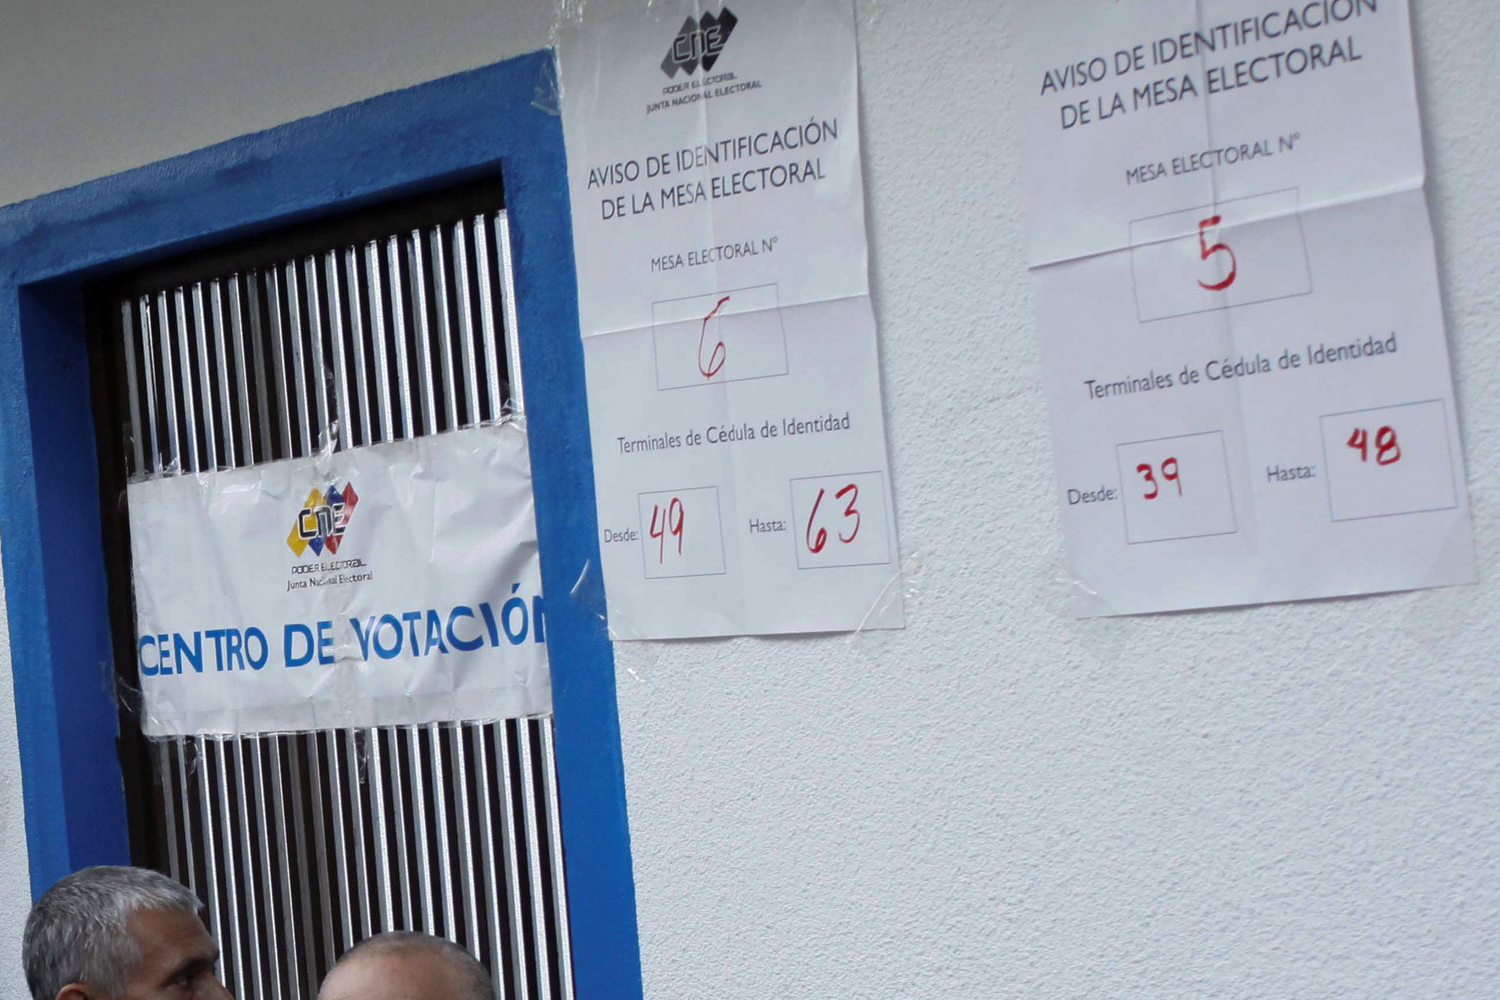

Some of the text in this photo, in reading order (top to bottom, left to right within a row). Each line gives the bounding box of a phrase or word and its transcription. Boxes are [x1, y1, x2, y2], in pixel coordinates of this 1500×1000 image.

[672, 25, 724, 63] CNE
[662, 83, 690, 95] PODER
[1040, 57, 1107, 96] AVISO
[1114, 45, 1145, 76] DE
[1060, 36, 1363, 130] DE LA MESA ELECTORAL
[646, 101, 670, 115] JUNTA
[715, 80, 762, 98] ELECTORAL
[587, 117, 838, 190] AVISO DE IDENTIFICACIÓN
[1126, 162, 1168, 186] MESA
[1172, 139, 1274, 176] ELECTORAL
[601, 157, 826, 220] DE LA MESA ELECTORAL
[651, 254, 685, 273] MESA
[688, 241, 758, 267] ELECTORAL
[1197, 215, 1237, 291] 5
[698, 295, 730, 380] 6
[1084, 331, 1397, 400] Terminales de Cédula de Identidad
[617, 411, 850, 454] Terminales de Cédula de Identidad
[1346, 425, 1401, 466] 48
[1136, 456, 1183, 500] 39
[1267, 464, 1316, 482] Hasta:
[1067, 485, 1118, 505] Desde:
[298, 502, 347, 540] CNE
[604, 529, 639, 543] Desde:
[650, 496, 685, 564] 49
[750, 518, 787, 534] Hasta:
[806, 483, 860, 554] 63
[287, 580, 307, 593] Junta
[338, 570, 373, 585] Electoral
[291, 558, 367, 575] PODER ELECTORAL
[138, 626, 268, 677] CENTRO
[283, 620, 335, 668] DE
